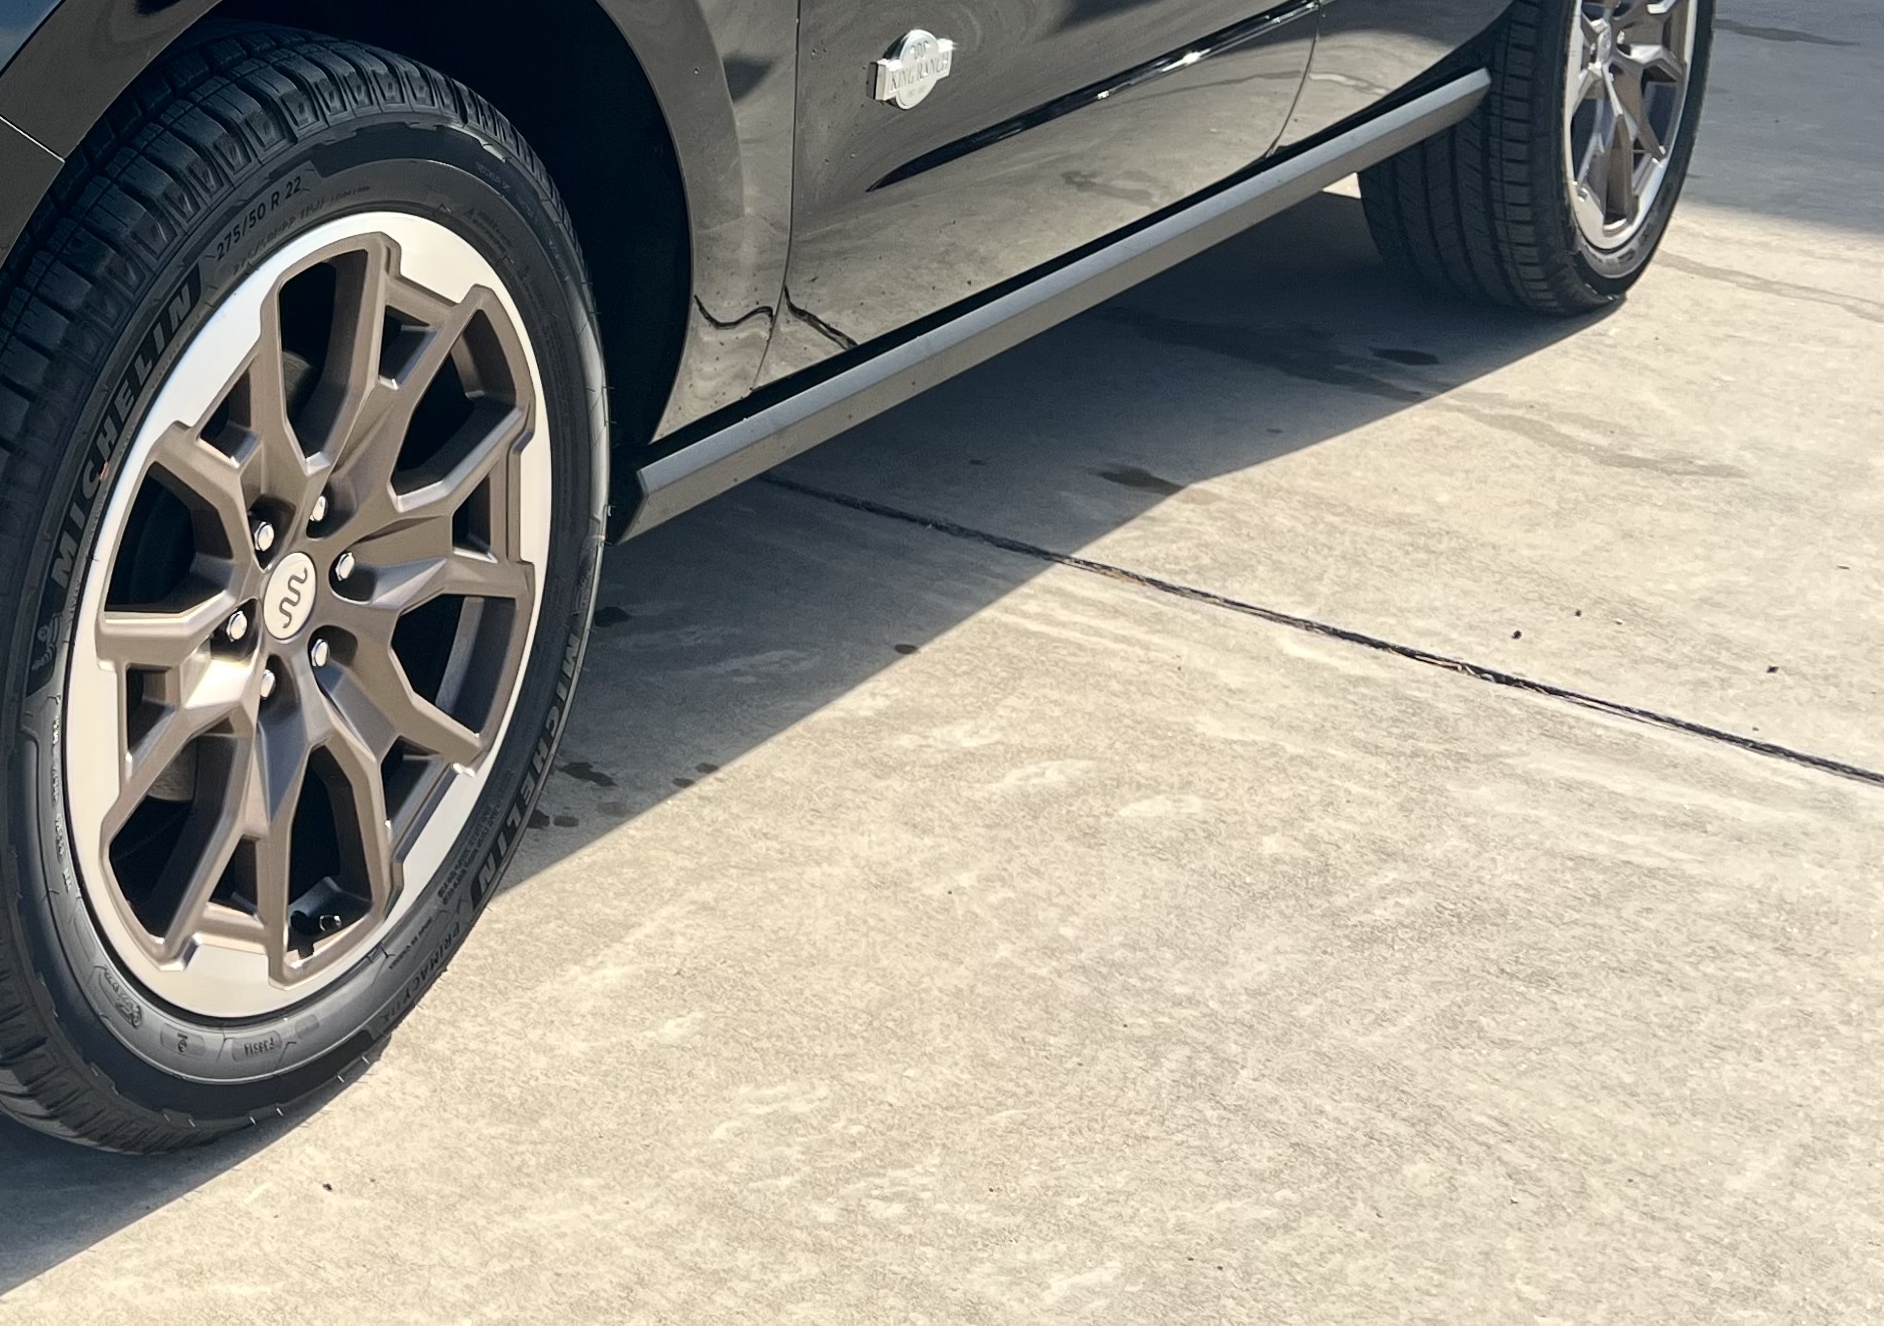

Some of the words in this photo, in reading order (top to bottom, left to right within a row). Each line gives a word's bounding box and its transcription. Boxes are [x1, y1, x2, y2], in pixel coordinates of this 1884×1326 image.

[216, 202, 267, 262] 275/50
[270, 190, 281, 212] R
[284, 175, 302, 201] 22
[50, 283, 193, 590] MICHELIN
[476, 633, 579, 890] MICHELIN
